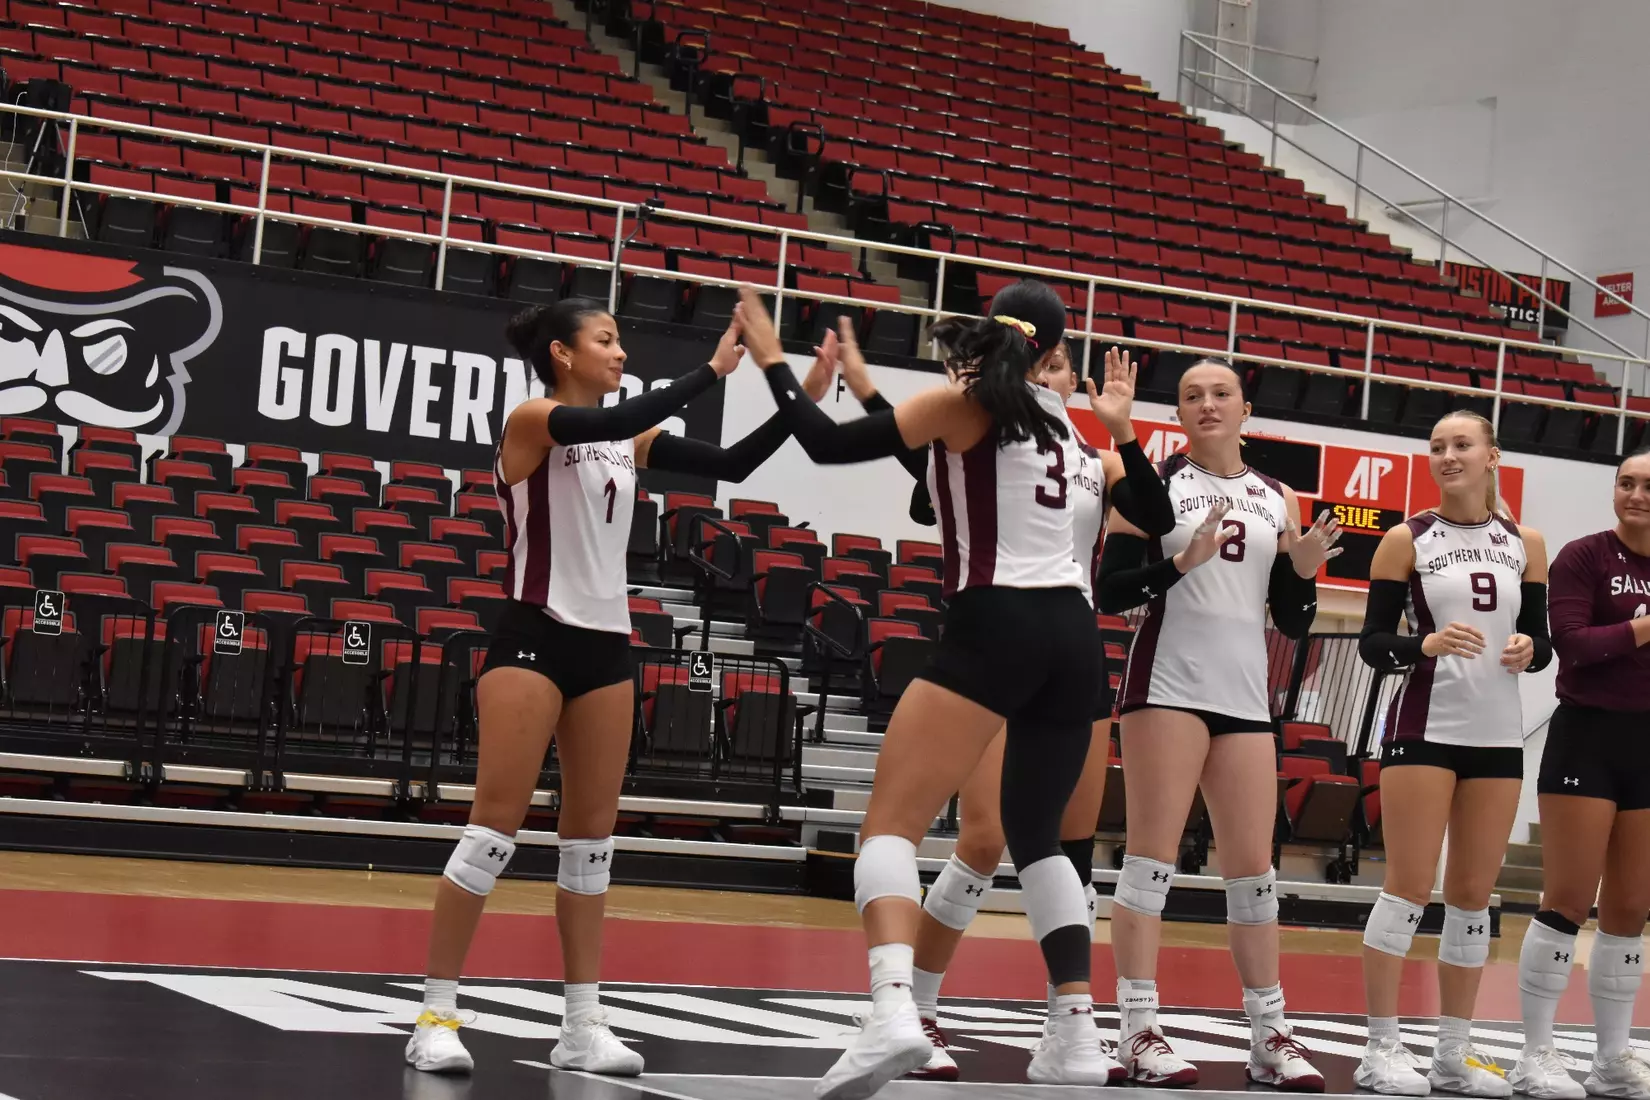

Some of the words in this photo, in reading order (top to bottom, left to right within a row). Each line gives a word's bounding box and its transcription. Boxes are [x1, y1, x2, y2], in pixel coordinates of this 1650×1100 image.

[1598, 282, 1632, 295] HELTER
[1034, 438, 1068, 509] 3
[1345, 455, 1394, 501] AP
[603, 476, 617, 524] 1
[1236, 498, 1276, 529] ILLINOIS
[1333, 504, 1381, 529] SIUE
[1220, 519, 1246, 562] 8
[1428, 548, 1482, 574] SOUTHERN
[1484, 548, 1521, 576] ILLINOIS
[1469, 572, 1498, 612] 9
